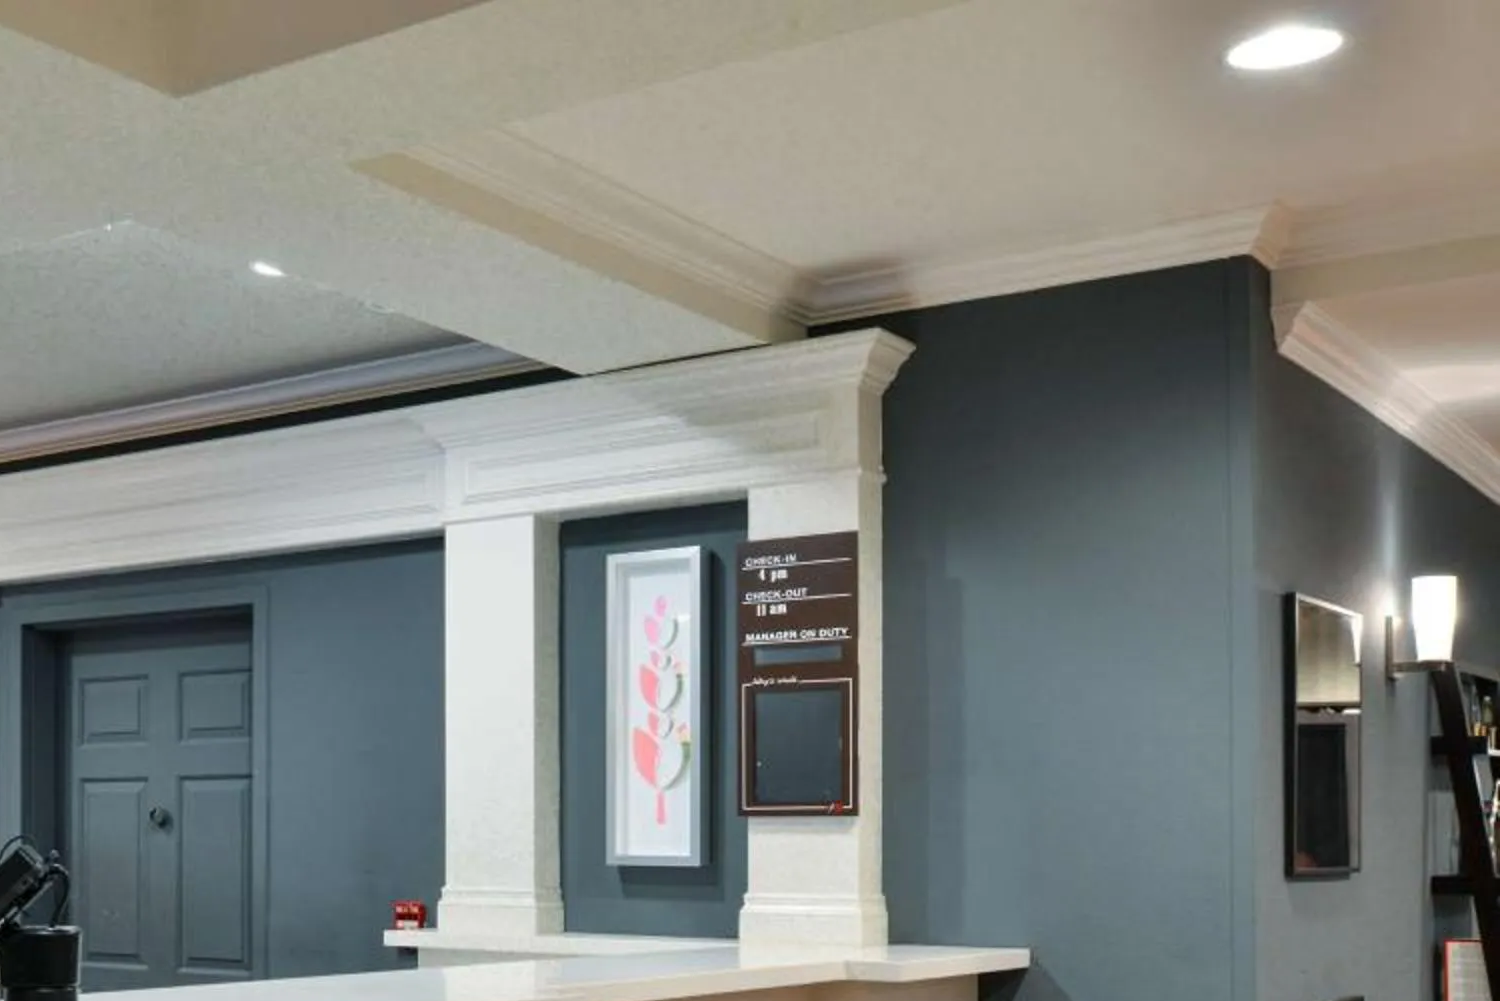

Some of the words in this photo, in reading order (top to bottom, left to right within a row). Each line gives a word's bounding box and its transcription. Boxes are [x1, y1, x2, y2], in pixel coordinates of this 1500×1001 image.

[744, 553, 797, 567] CHECK-IN
[744, 587, 808, 601] CHECK-OUT
[769, 603, 787, 615] am
[744, 630, 797, 641] MANAGER
[800, 628, 816, 640] ON
[819, 627, 849, 639] DUTY
